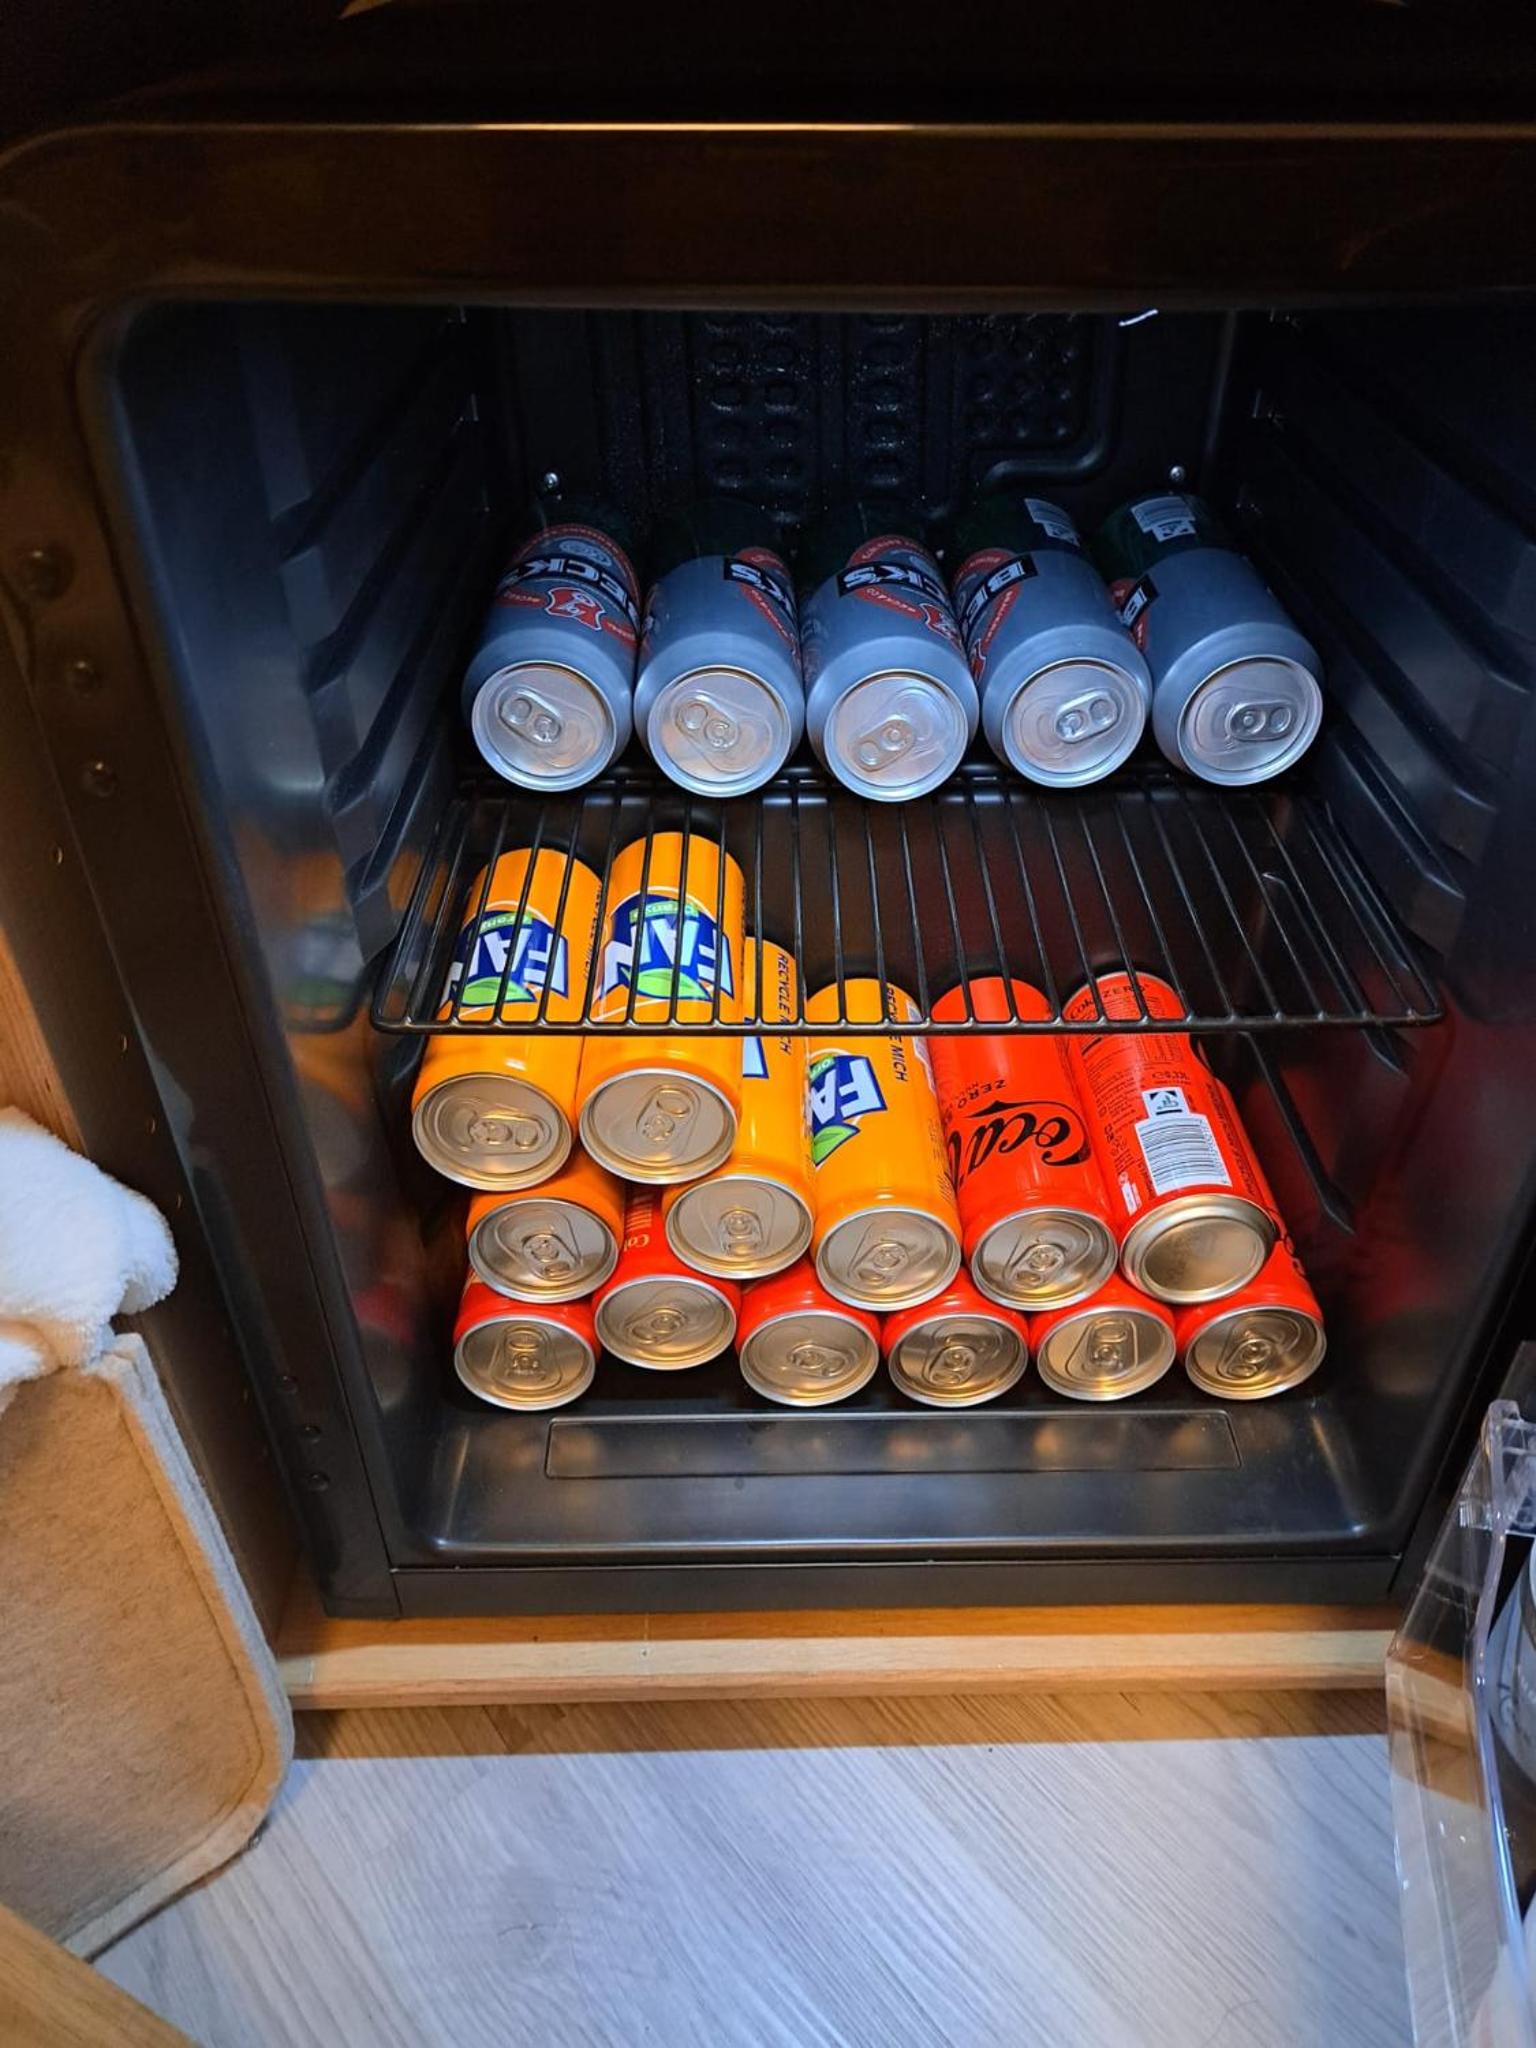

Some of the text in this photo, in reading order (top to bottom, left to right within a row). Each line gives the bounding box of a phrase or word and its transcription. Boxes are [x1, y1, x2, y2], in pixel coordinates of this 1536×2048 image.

[777, 953, 790, 1011] RECYCLE
[890, 1044, 908, 1082] MICH
[957, 1079, 1006, 1109] ZERO
